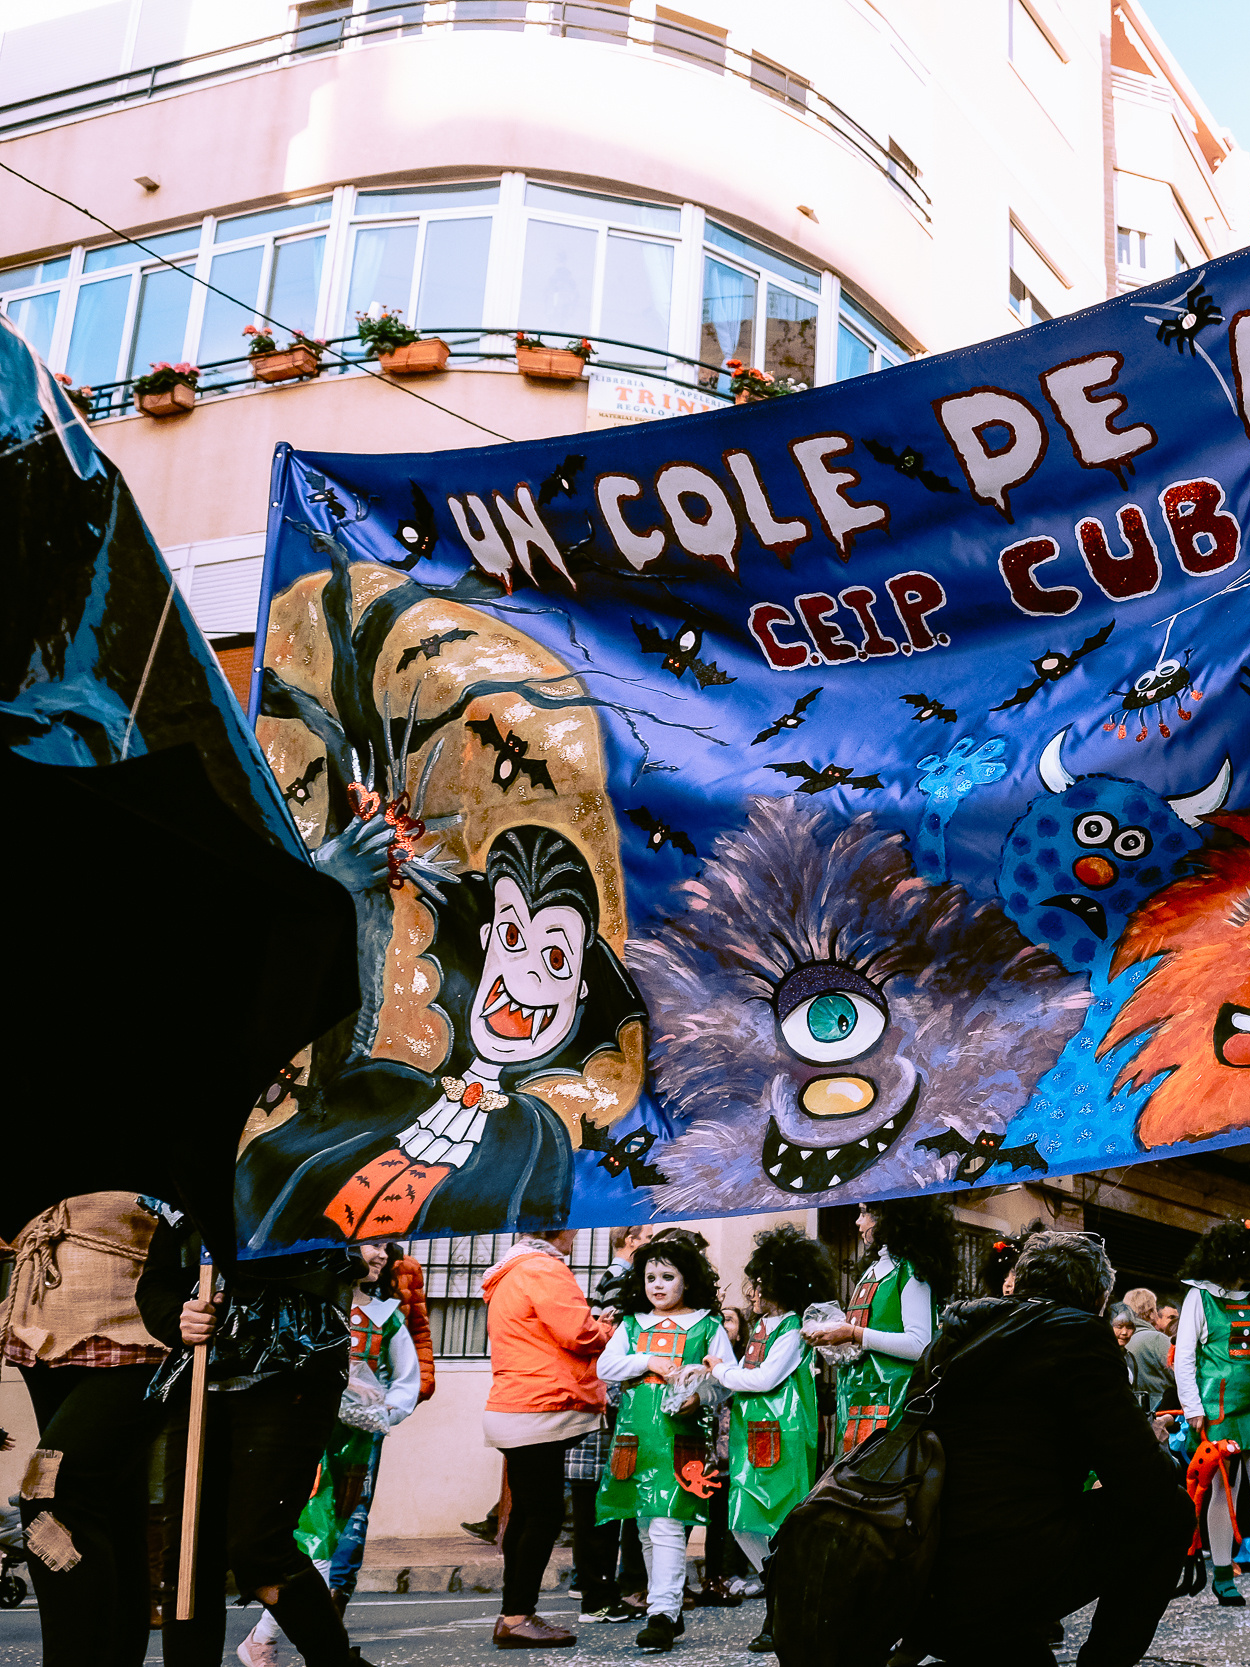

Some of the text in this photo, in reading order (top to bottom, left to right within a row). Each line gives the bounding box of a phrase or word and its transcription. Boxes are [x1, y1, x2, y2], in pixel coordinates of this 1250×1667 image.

[595, 375, 645, 388] LIBRERIA
[616, 402, 665, 416] REGALO
[598, 412, 633, 421] MATERIAL
[447, 482, 578, 596] UN
[594, 431, 892, 585] COLE
[930, 350, 1159, 524] DE
[748, 571, 951, 671] C.E.I.P.
